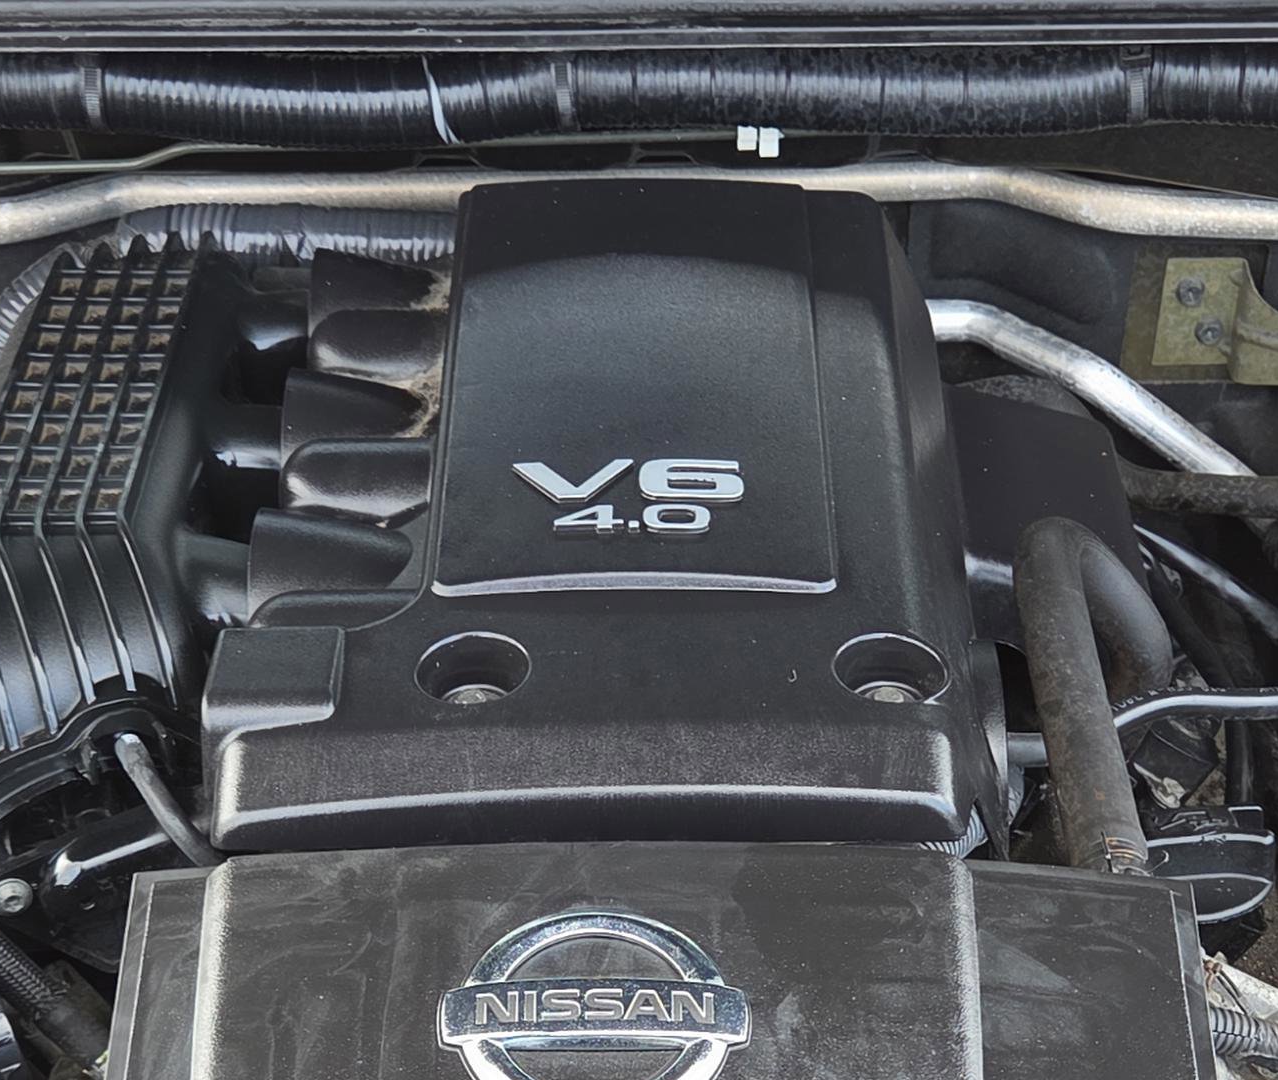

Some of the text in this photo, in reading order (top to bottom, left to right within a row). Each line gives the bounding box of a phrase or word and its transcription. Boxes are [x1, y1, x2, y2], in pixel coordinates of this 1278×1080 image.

[512, 458, 744, 503] V6
[553, 503, 711, 534] 4.0
[475, 988, 716, 1025] NISSAN
